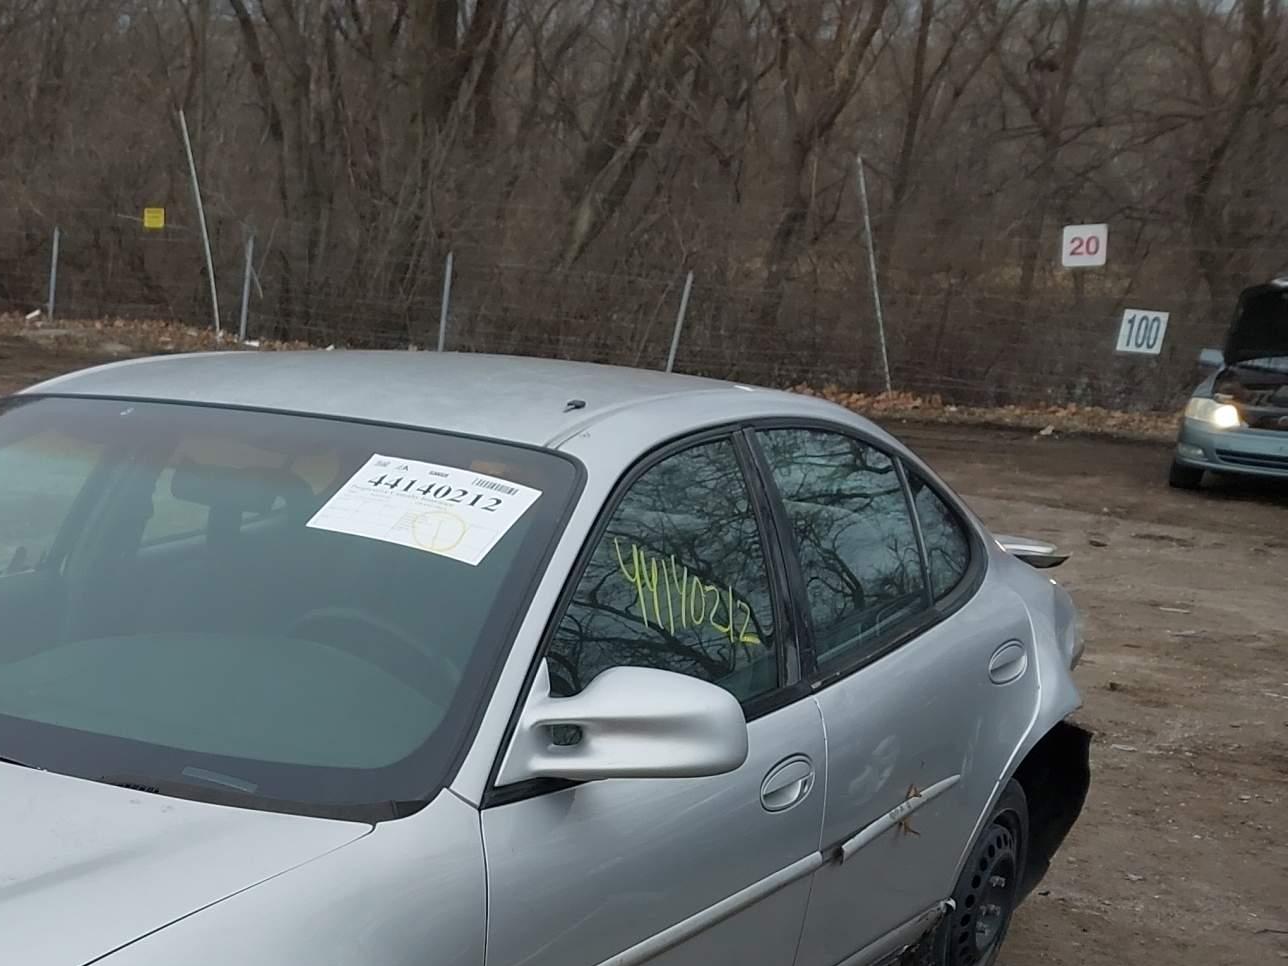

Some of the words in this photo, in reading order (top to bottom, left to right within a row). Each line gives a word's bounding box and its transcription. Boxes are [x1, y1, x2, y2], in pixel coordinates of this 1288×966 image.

[1068, 235, 1100, 256] 20
[1125, 314, 1162, 350] 100
[367, 473, 503, 512] 44140212
[614, 537, 761, 644] 44140212
